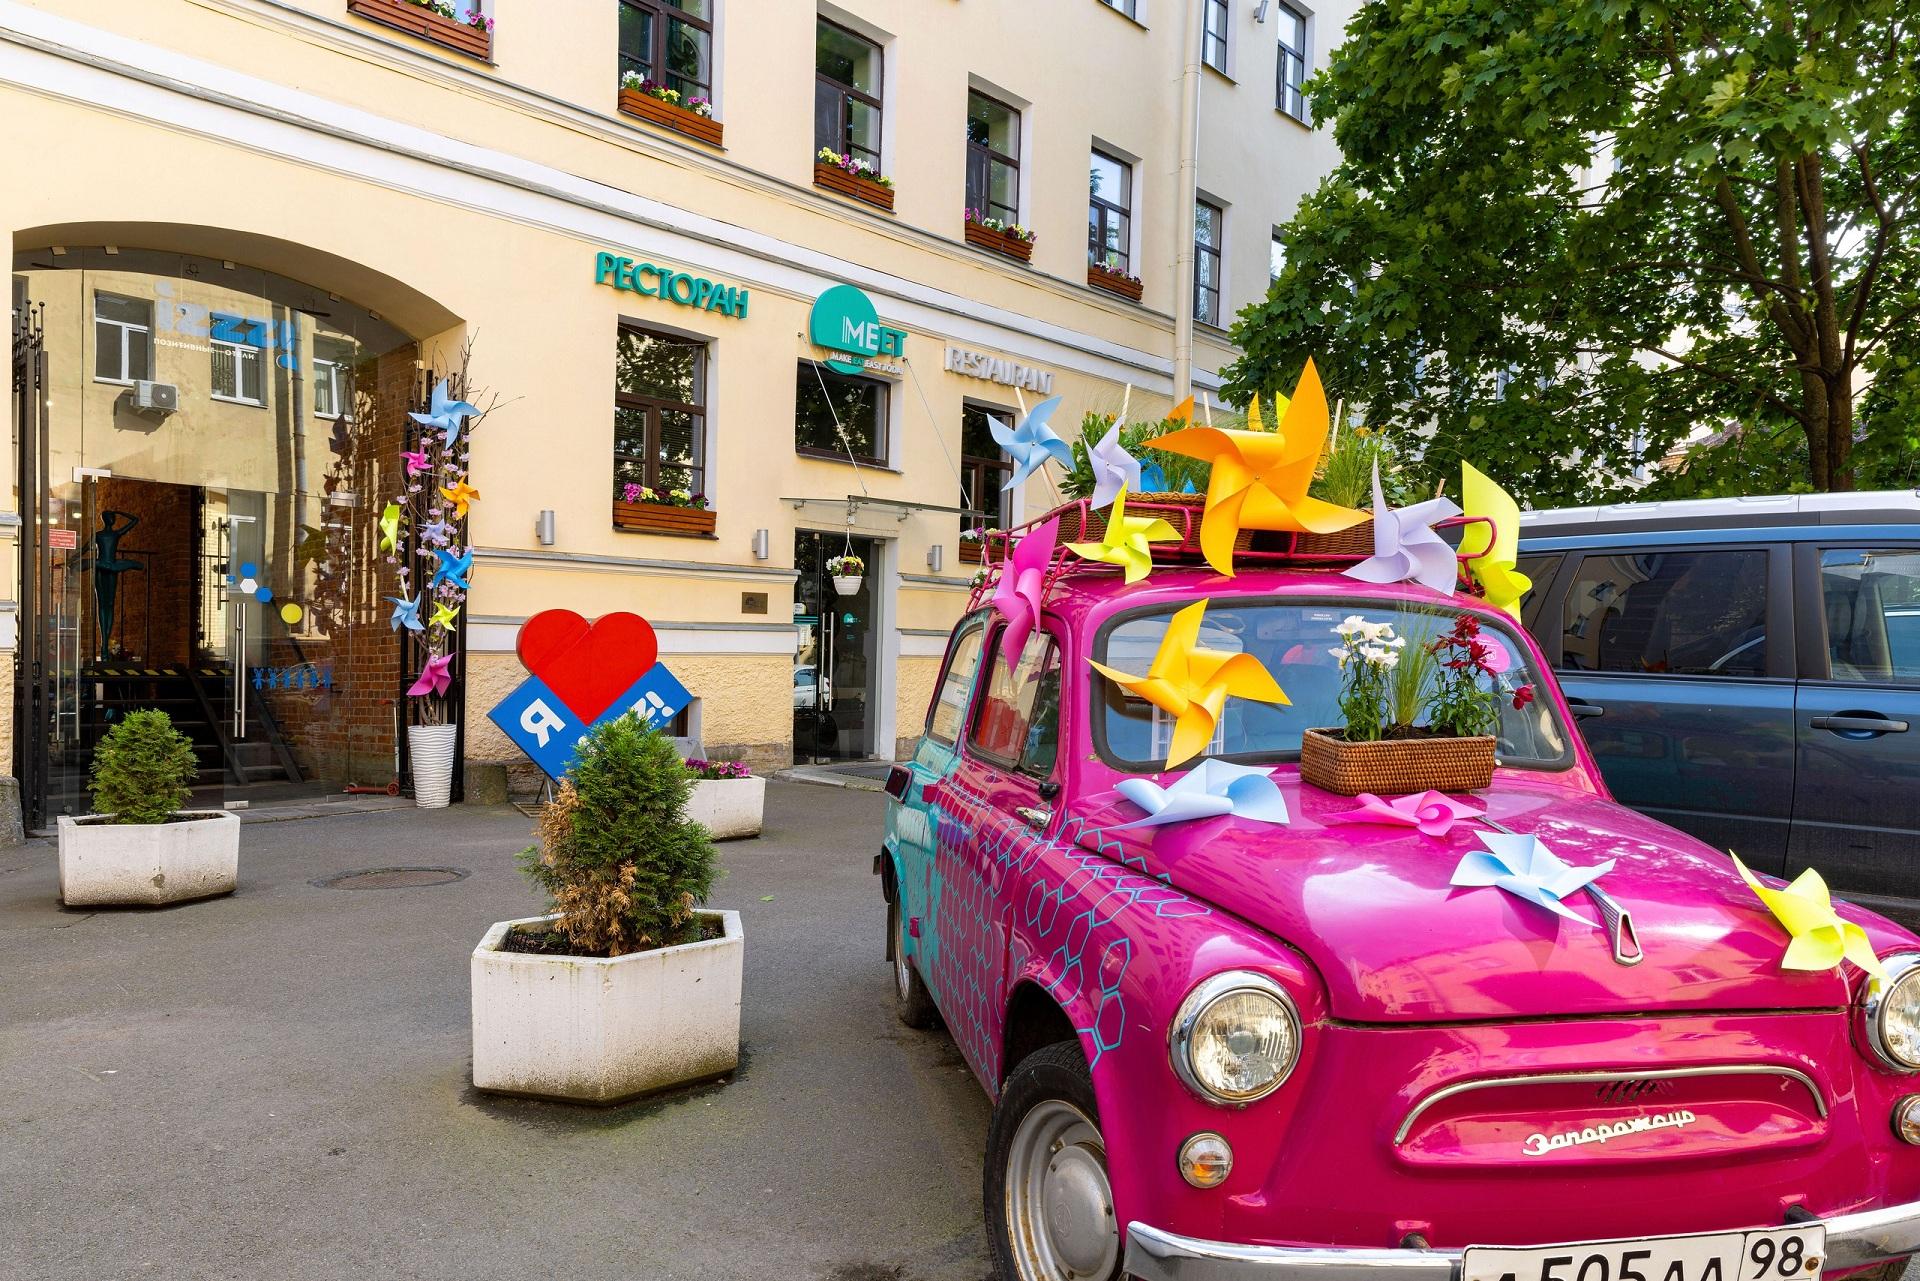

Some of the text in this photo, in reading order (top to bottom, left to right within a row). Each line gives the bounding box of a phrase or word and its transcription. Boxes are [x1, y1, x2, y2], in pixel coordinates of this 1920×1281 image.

[595, 251, 749, 319] РЕСТОРАН
[831, 351, 852, 364] MAKE
[841, 315, 908, 357] MEET
[944, 346, 1055, 395] RESTAURANT
[519, 698, 566, 748] Я
[1750, 1235, 1804, 1279] 98
